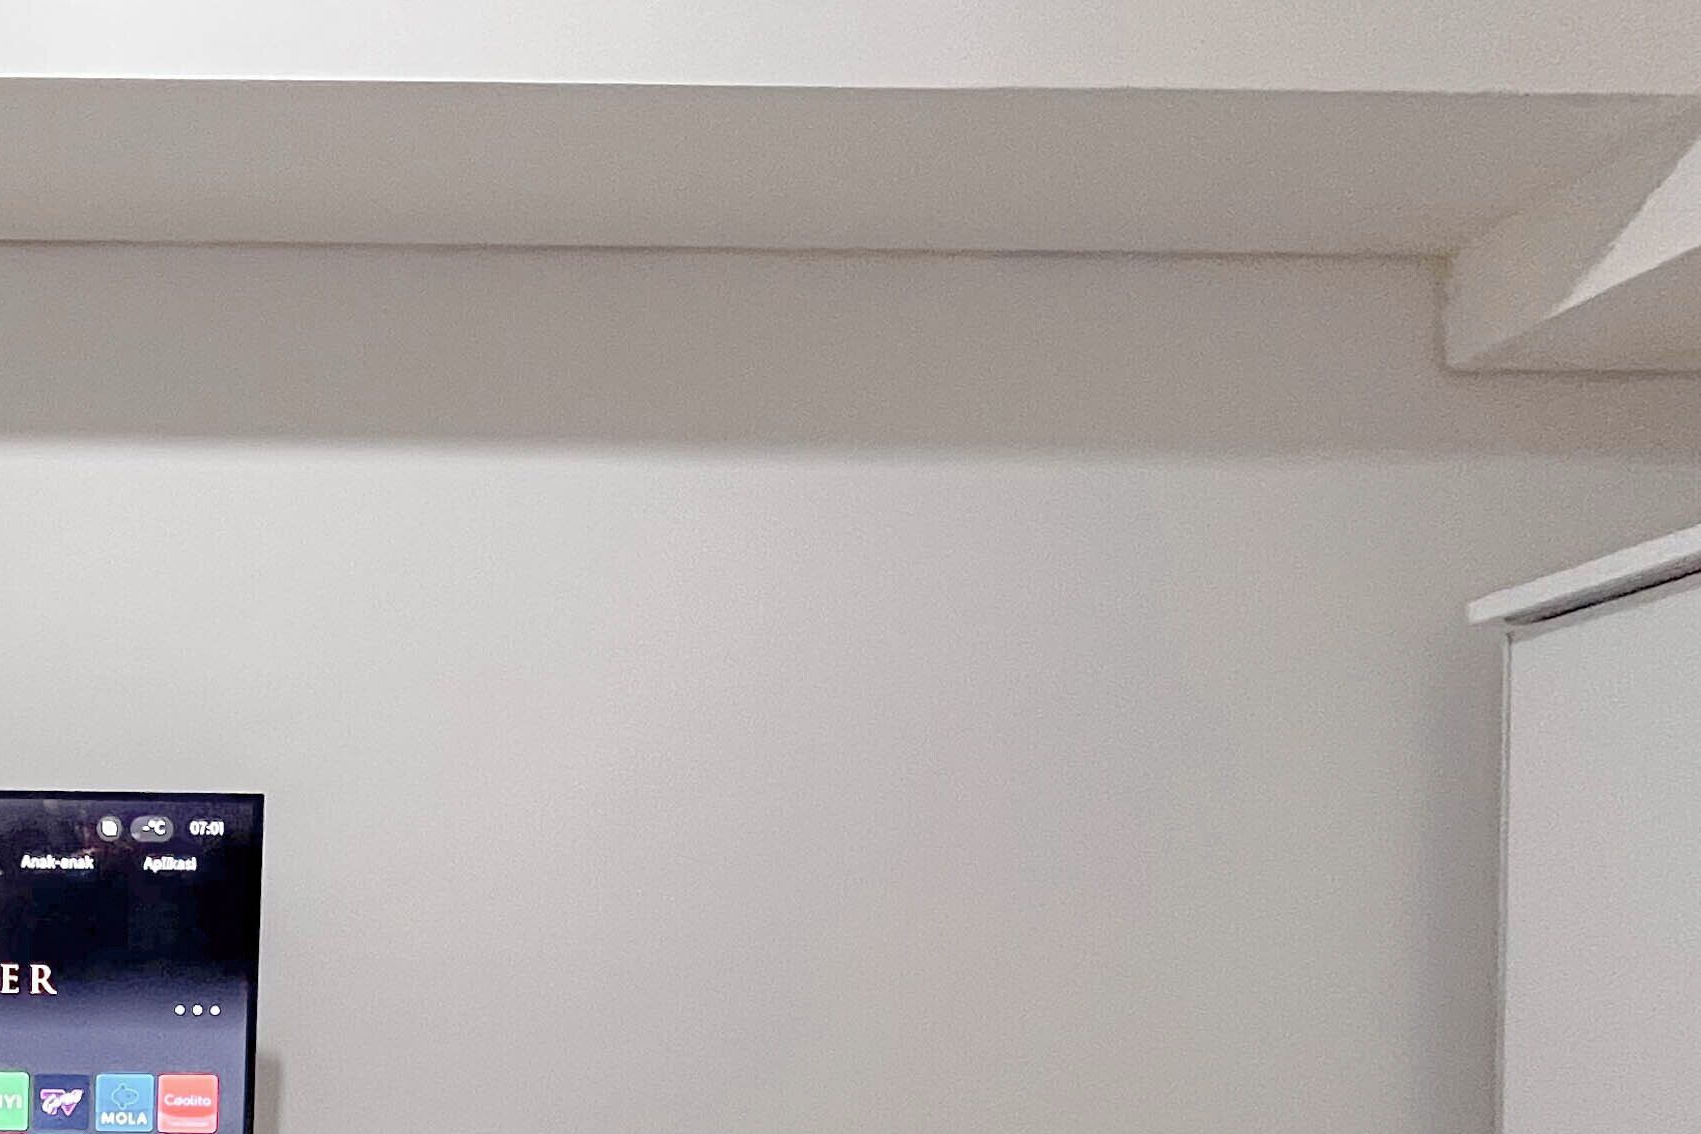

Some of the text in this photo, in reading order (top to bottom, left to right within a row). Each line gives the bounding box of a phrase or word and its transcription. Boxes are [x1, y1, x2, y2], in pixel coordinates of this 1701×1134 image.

[189, 821, 225, 836] 07:01
[143, 856, 197, 873] Aplikasi
[100, 1111, 148, 1125] MOLA
